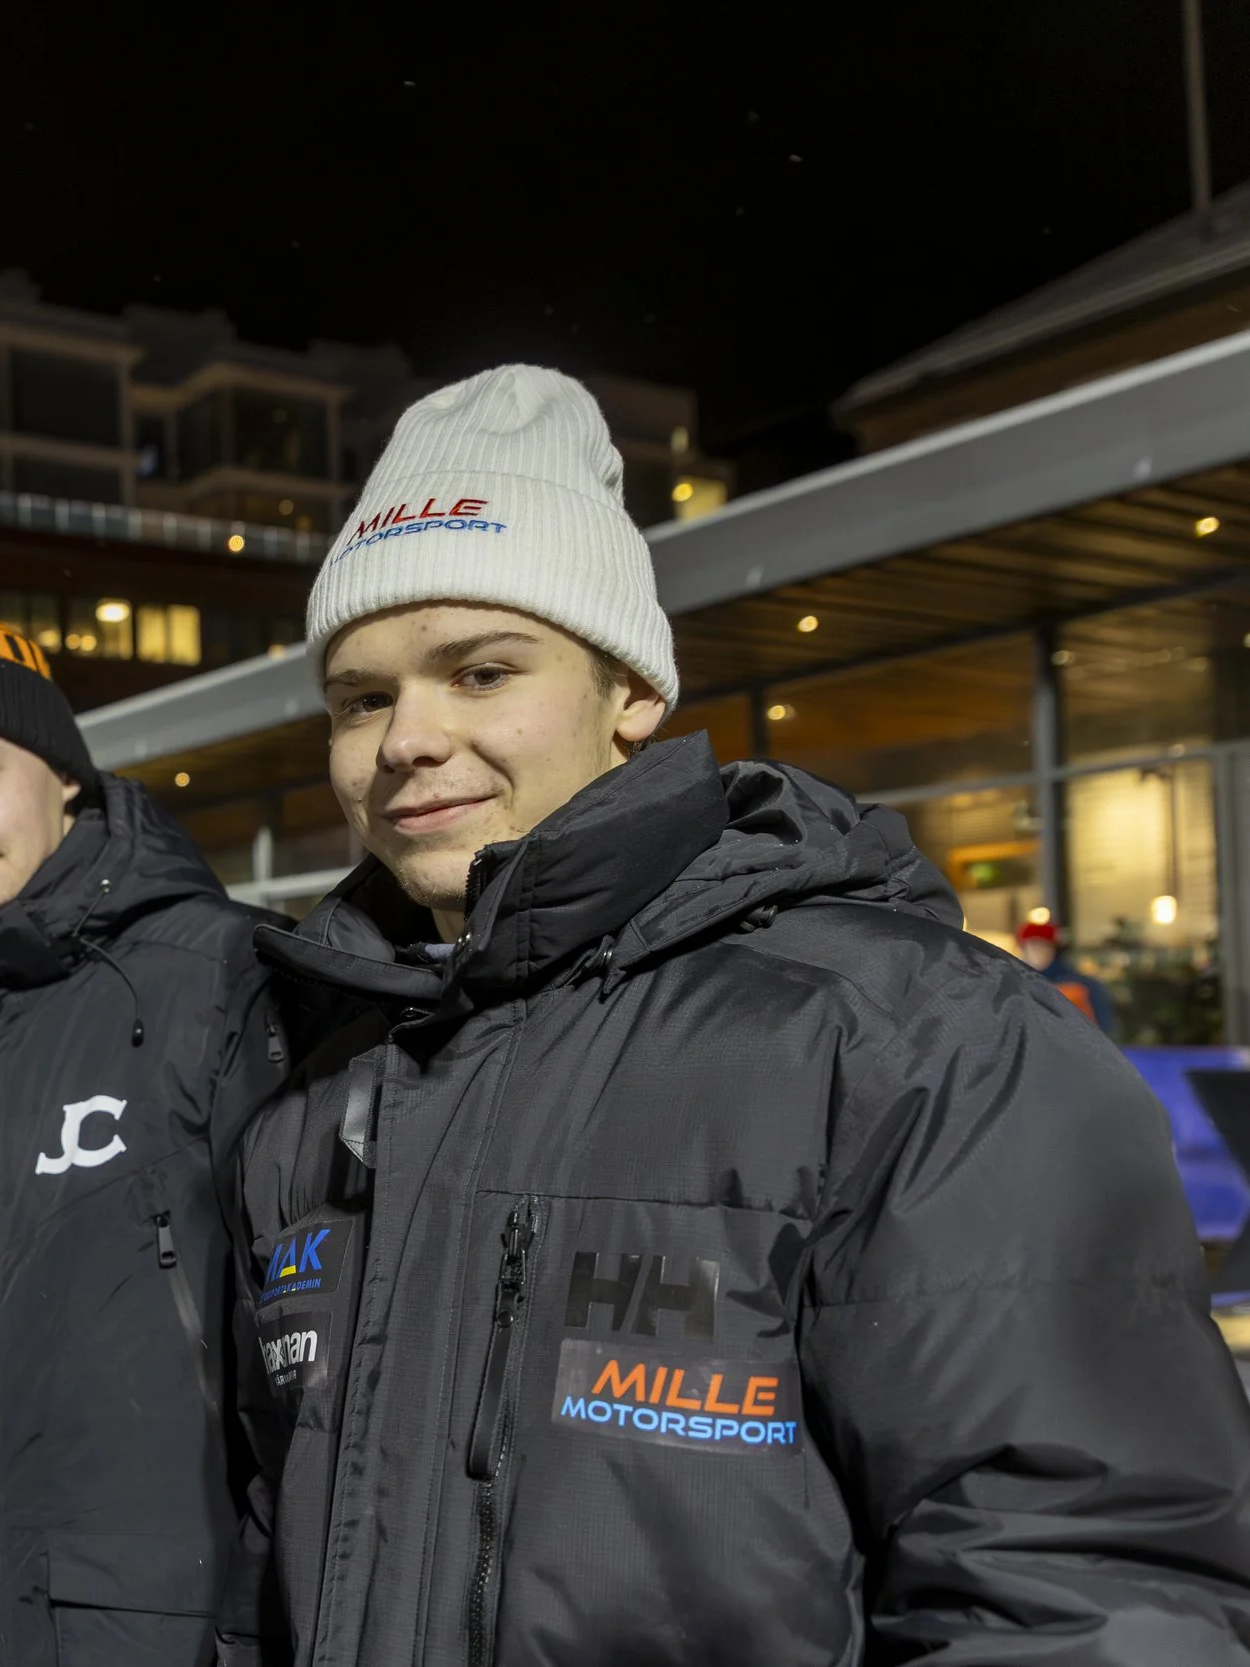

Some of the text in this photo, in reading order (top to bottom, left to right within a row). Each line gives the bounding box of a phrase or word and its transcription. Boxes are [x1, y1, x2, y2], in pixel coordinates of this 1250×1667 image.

[347, 498, 489, 546] MILLE
[565, 1251, 720, 1343] HH
[591, 1359, 779, 1416] MILLE
[561, 1396, 797, 1444] MOTORSPORT
